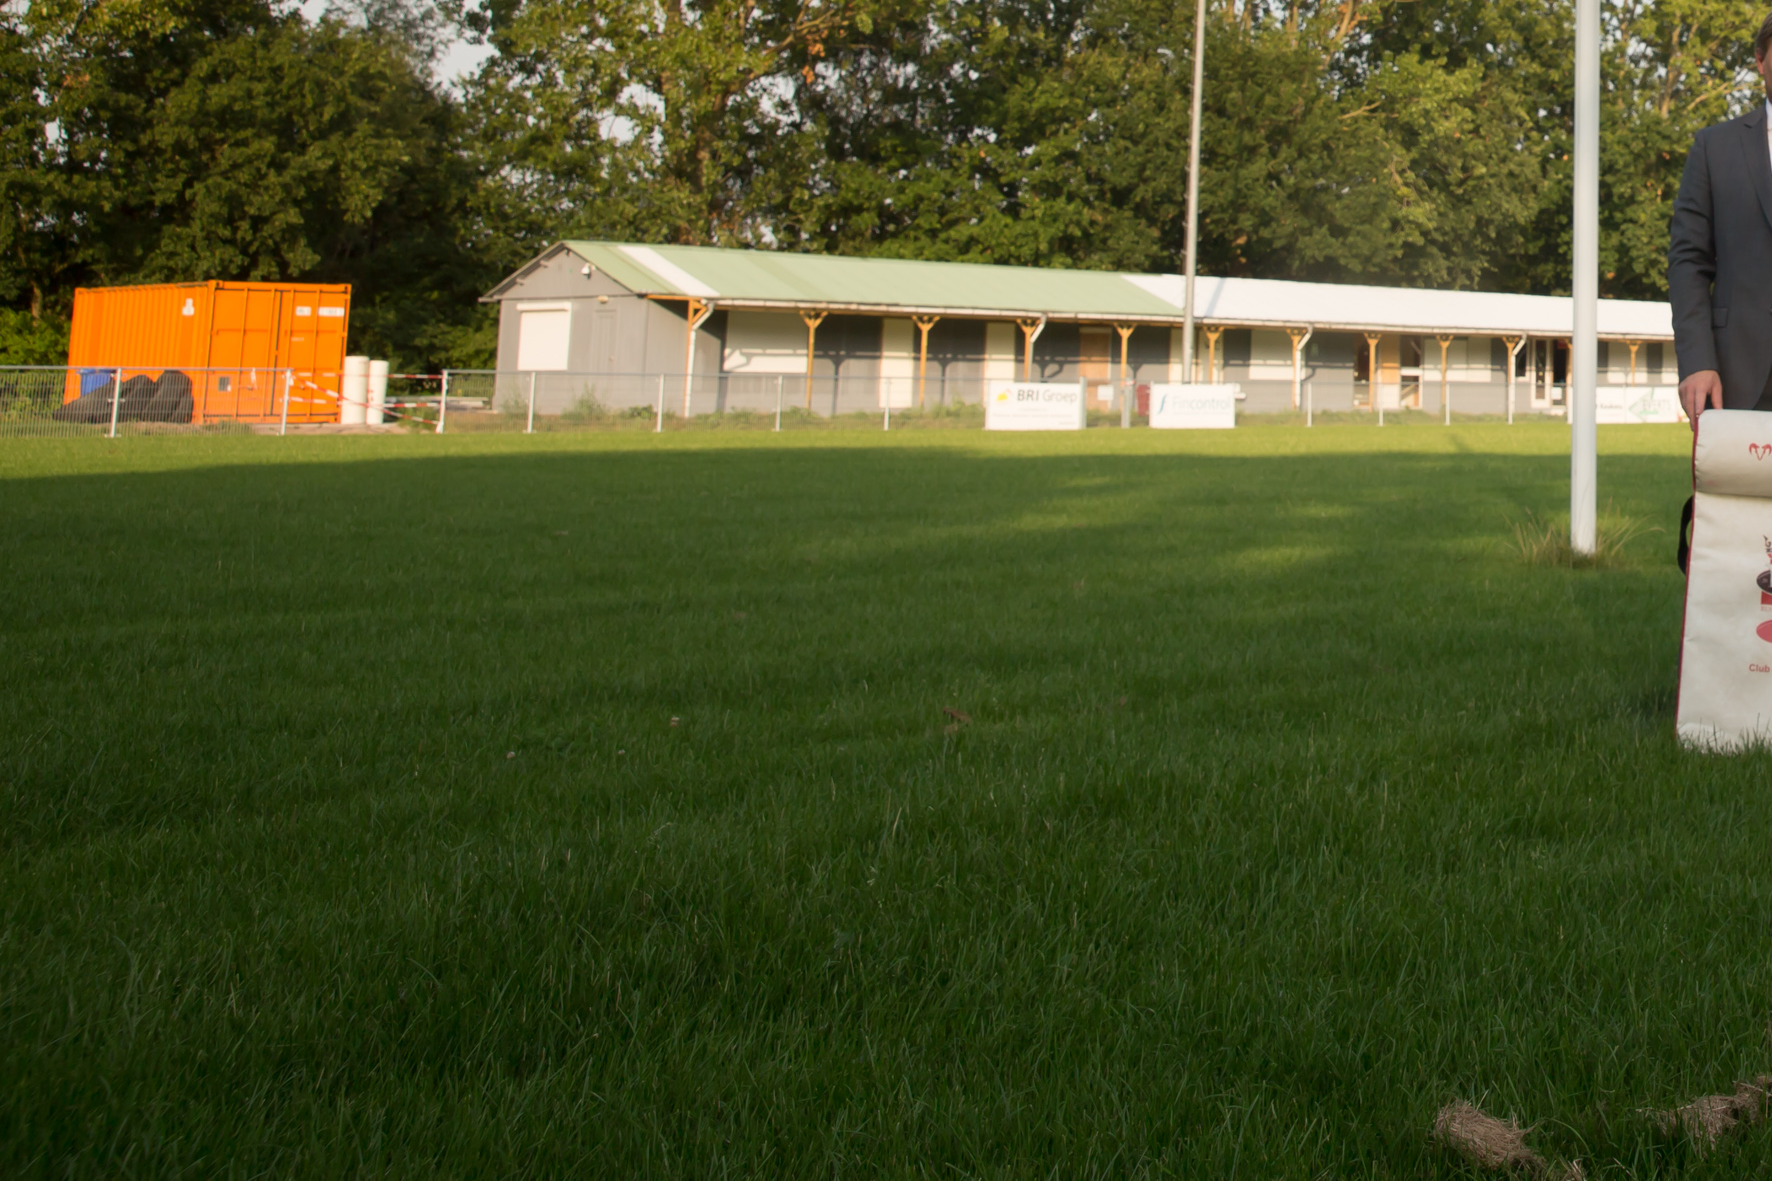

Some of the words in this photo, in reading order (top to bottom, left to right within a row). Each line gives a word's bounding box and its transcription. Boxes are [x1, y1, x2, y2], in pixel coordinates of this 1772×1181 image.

[1017, 389, 1039, 401] BRI
[1043, 389, 1077, 404] Groep
[1172, 395, 1230, 410] Fincontrol
[1749, 663, 1770, 673] Club
